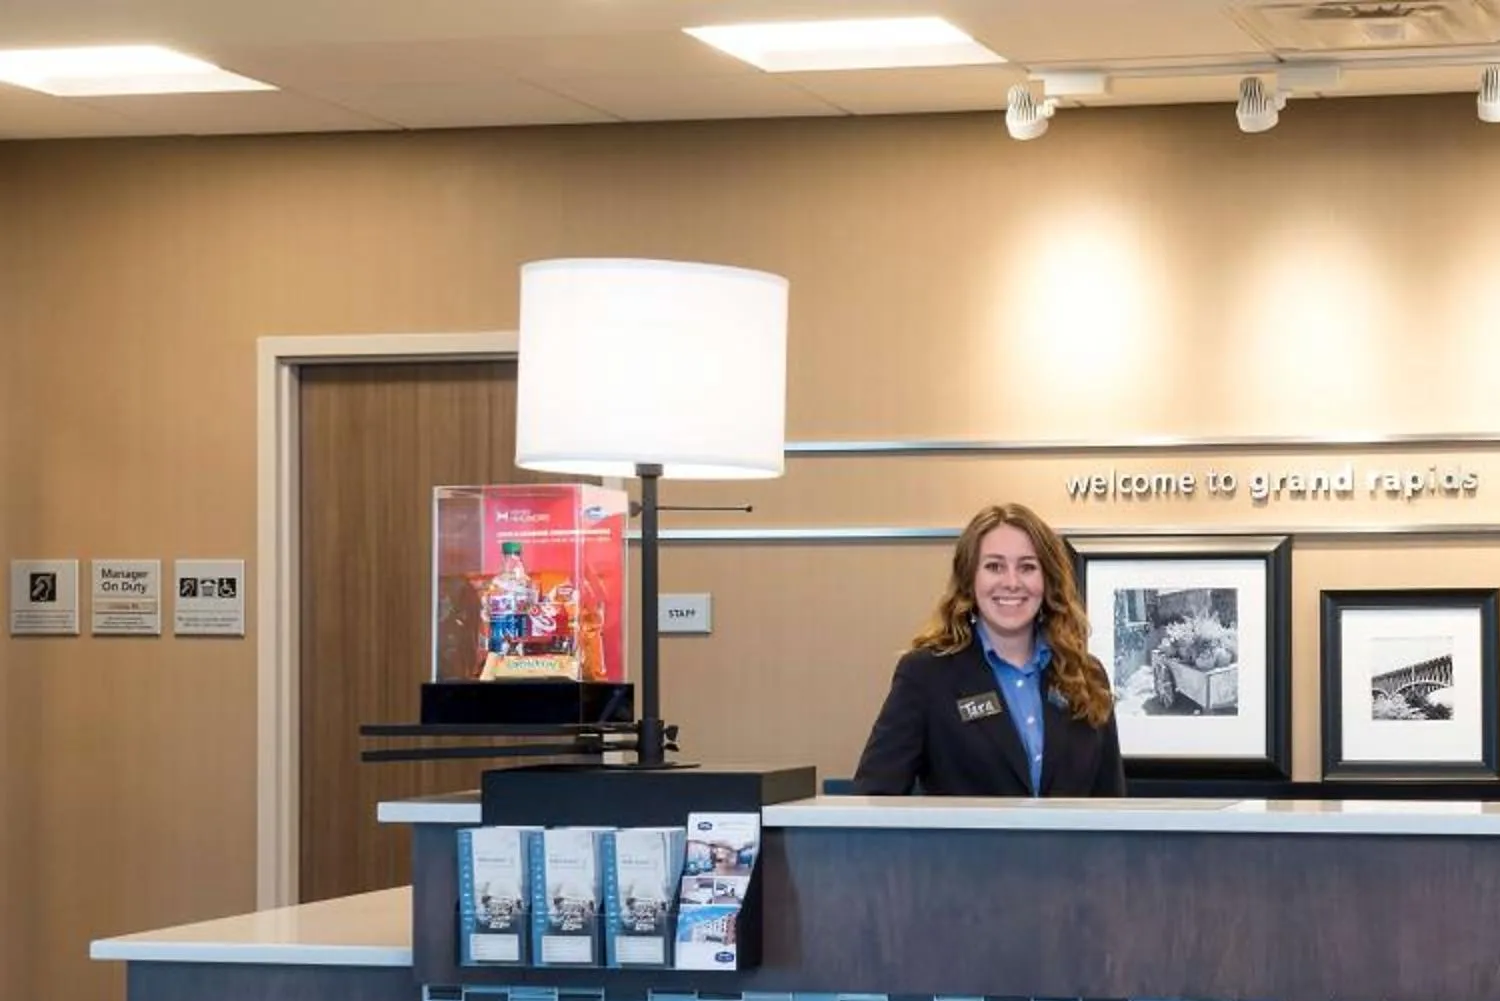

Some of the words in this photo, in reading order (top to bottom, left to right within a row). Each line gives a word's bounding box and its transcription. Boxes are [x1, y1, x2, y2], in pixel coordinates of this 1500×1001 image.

[1066, 466, 1196, 497] welcome
[1207, 467, 1238, 494] to
[1249, 465, 1354, 502] grand
[1369, 465, 1479, 502] rapids
[101, 568, 149, 581] Manager
[102, 581, 119, 592] On
[121, 581, 147, 595] Duty
[668, 608, 696, 618] STAFF
